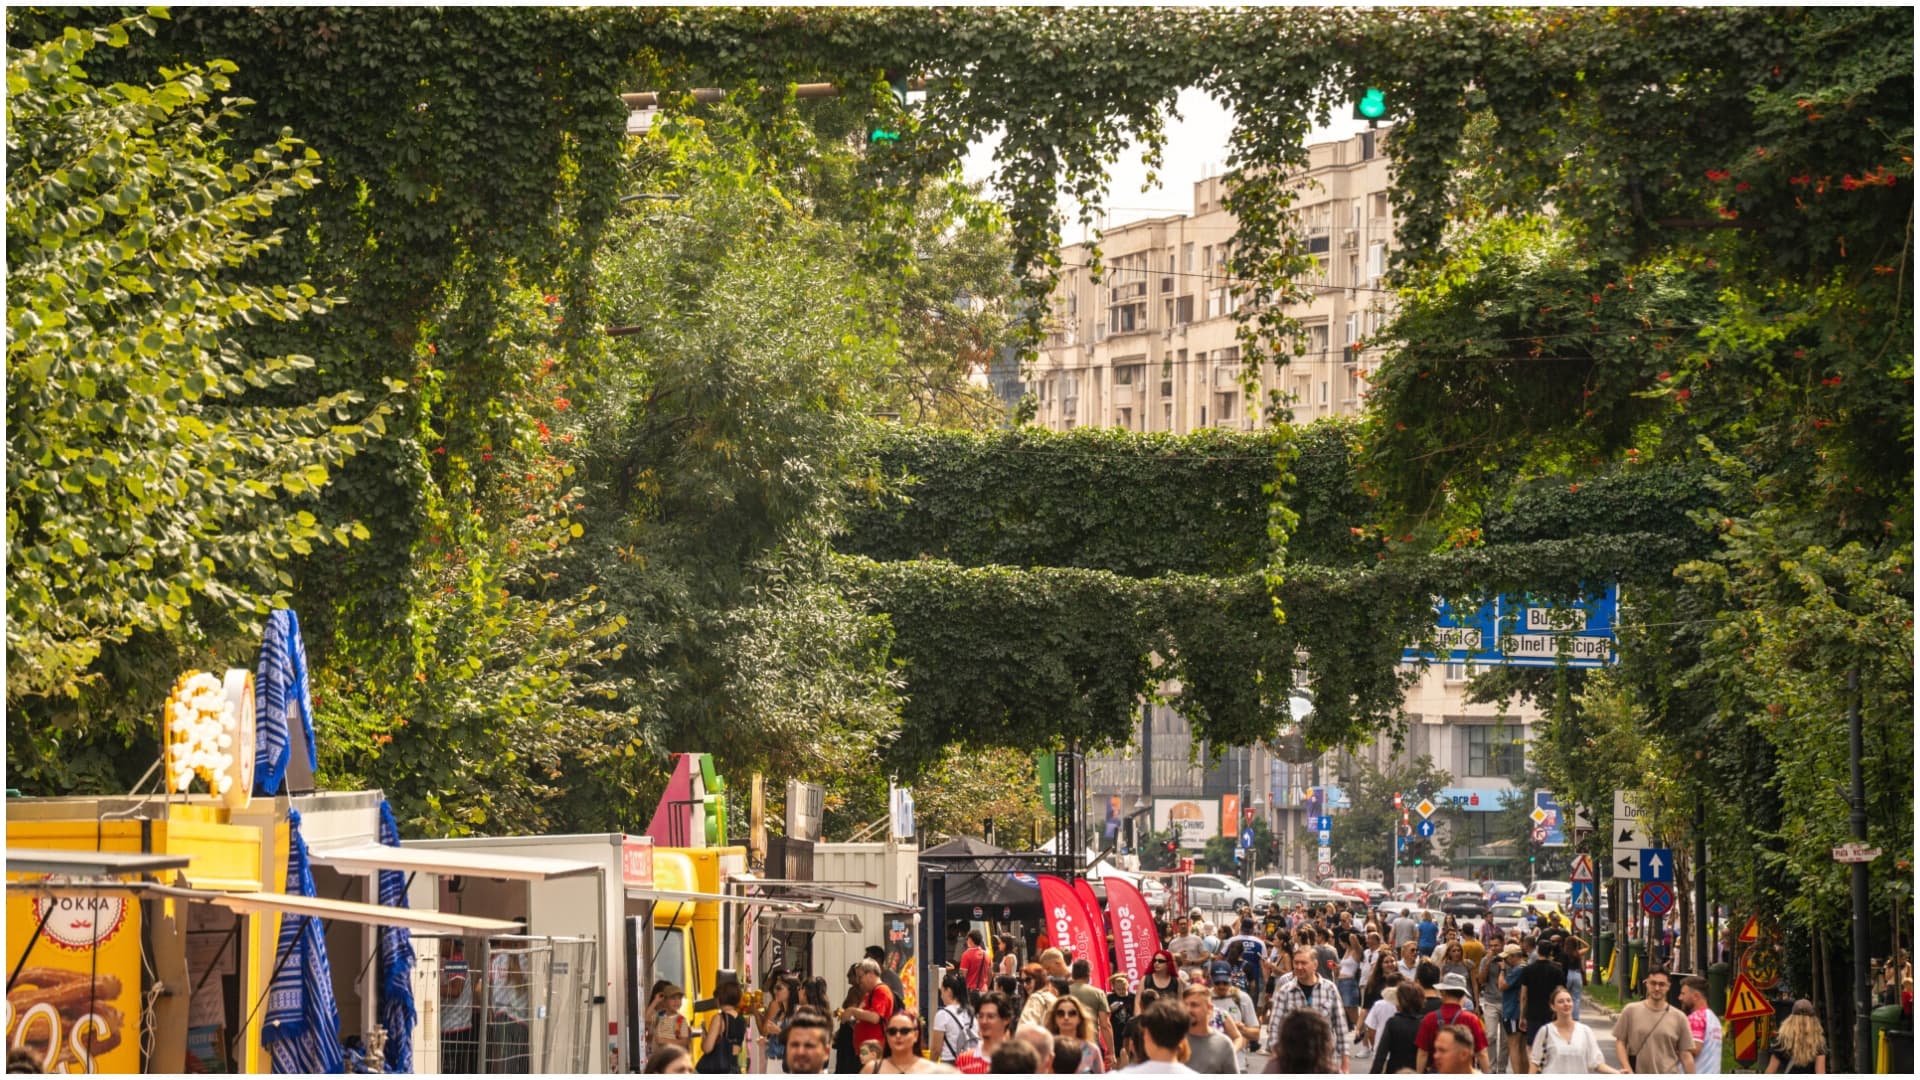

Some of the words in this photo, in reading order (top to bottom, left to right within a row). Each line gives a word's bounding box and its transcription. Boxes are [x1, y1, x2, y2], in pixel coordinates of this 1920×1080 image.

[1521, 636, 1544, 651] Inel
[1549, 637, 1607, 657] Pncipal
[1453, 796, 1469, 805] BCR
[51, 898, 110, 911] OKKA
[6, 1000, 111, 1074] OS
